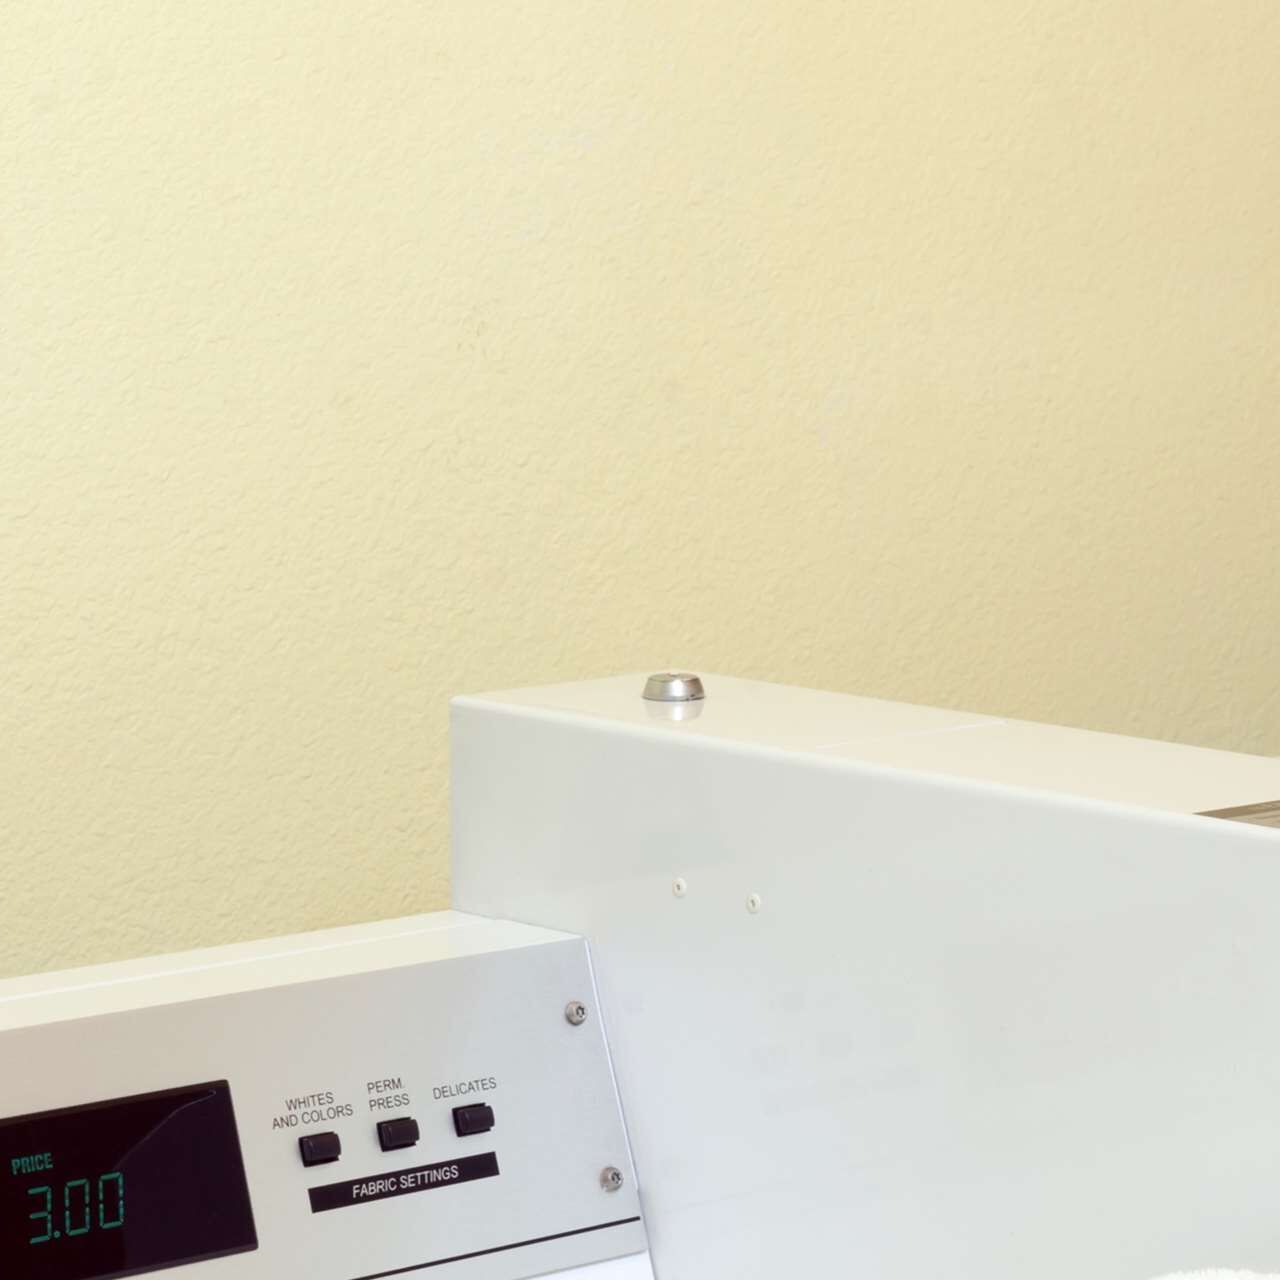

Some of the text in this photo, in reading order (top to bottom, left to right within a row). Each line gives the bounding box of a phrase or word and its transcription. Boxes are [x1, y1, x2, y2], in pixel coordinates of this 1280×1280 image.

[366, 1078, 405, 1095] PERM.
[432, 1077, 497, 1100] DELICATES
[285, 1091, 334, 1113] WHITES
[368, 1093, 411, 1112] PRESS
[272, 1104, 353, 1129] AND COLORS
[11, 1152, 54, 1176] PRICE
[352, 1164, 459, 1199] FABRIC SETTINGS
[28, 1172, 124, 1244] 3.00
